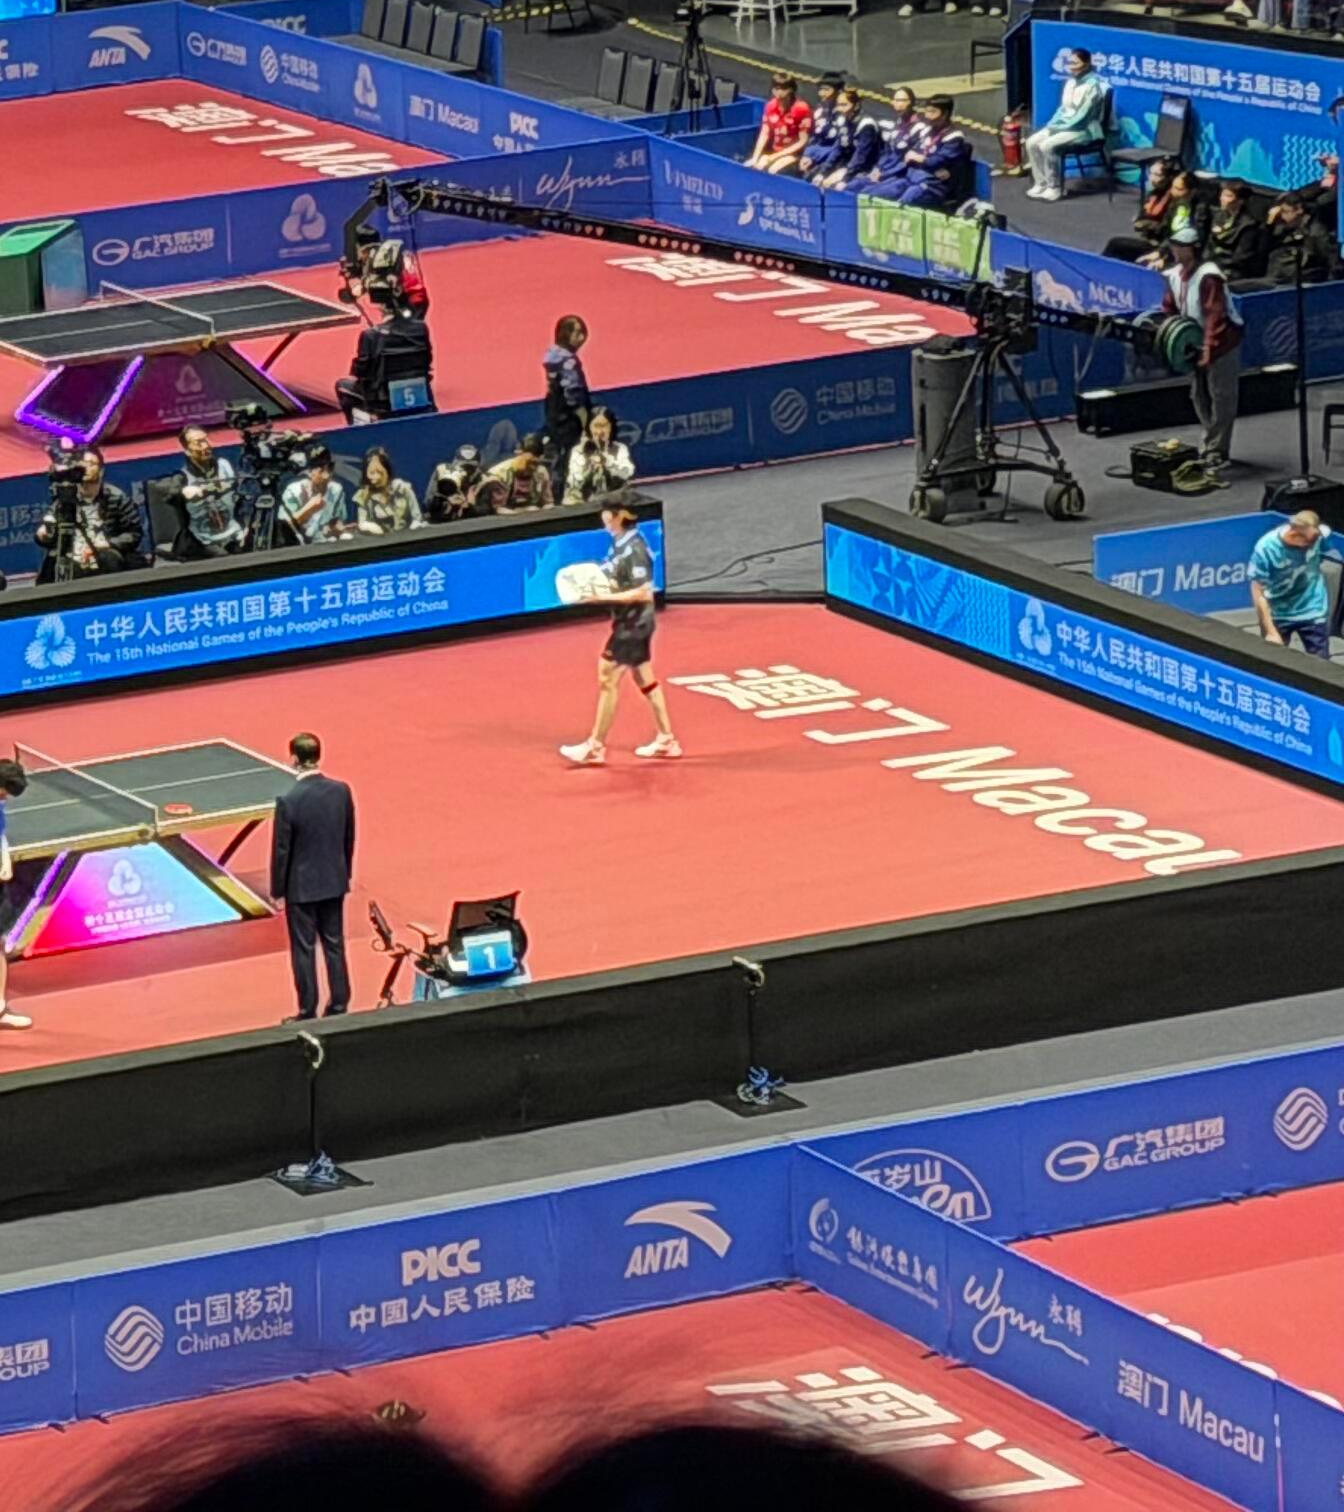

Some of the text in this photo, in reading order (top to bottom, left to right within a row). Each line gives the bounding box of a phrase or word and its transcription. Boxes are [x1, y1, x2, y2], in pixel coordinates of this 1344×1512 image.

[89, 48, 126, 69] ANTA
[1091, 51, 1322, 103] 中华人民共和国第十五届运动会
[1175, 560, 1250, 593] Maca
[84, 566, 448, 646] 中华人民共和国第十五届运动会
[88, 647, 110, 665] The
[146, 634, 199, 656] National
[201, 628, 245, 649] Games
[247, 625, 262, 642] of
[263, 622, 284, 639] the
[286, 613, 339, 637] People's
[342, 605, 395, 630] Republic
[397, 602, 411, 618] of
[413, 597, 449, 617] China
[1056, 619, 1312, 735] 中华人民共和国第十五届运动会
[1058, 651, 1076, 670] The
[665, 664, 952, 745] 澳门
[484, 942, 498, 969] 1
[1103, 1136, 1226, 1172] GAC GROUP
[1105, 1115, 1225, 1155] 广汽集团
[401, 1238, 482, 1287] PICC
[624, 1236, 689, 1280] ANTA
[174, 1281, 294, 1332] 中国移动
[349, 1274, 536, 1336] 中国人民保险
[176, 1317, 294, 1357] China Mobile
[1117, 1359, 1265, 1465] 澳门 Macau
